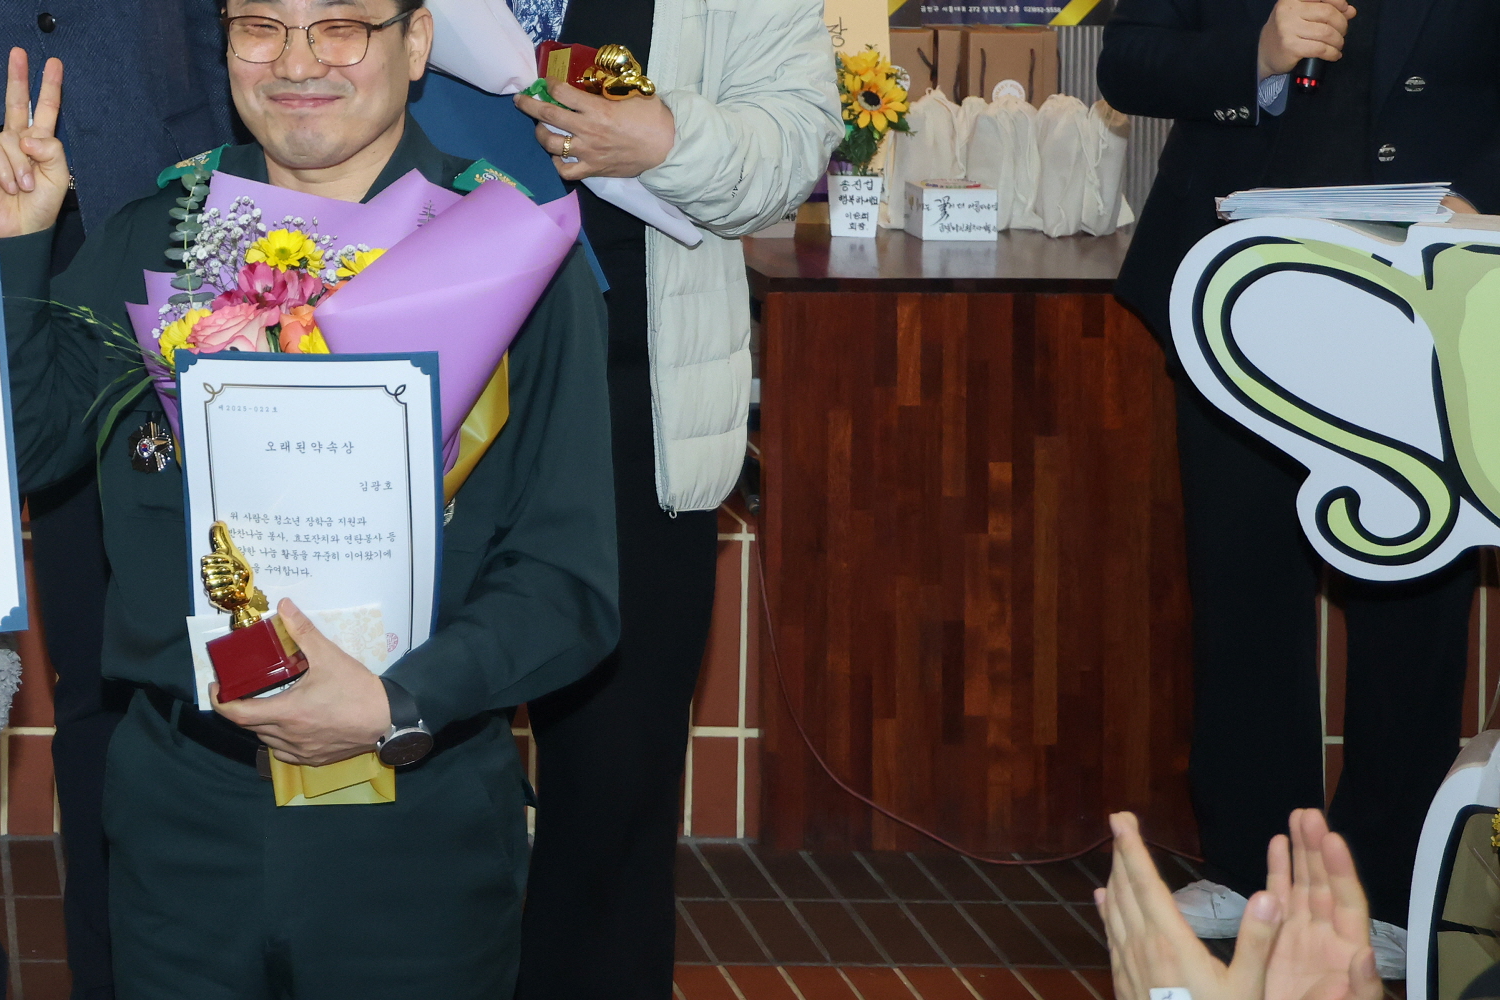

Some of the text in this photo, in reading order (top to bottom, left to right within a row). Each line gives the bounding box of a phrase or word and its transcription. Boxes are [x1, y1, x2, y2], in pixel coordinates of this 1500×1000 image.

[230, 511, 367, 528] 위 사람은 청소년 장학금 지원과
[292, 532, 340, 544] 효도잔치와
[343, 532, 383, 545] 연탄봉사
[386, 531, 397, 542] 등
[259, 547, 278, 559] 나눔
[281, 549, 308, 561] 활동을
[312, 550, 340, 562] 꾸준히
[344, 548, 392, 561] 이어왔기에
[264, 563, 313, 578] 수여합니다.
